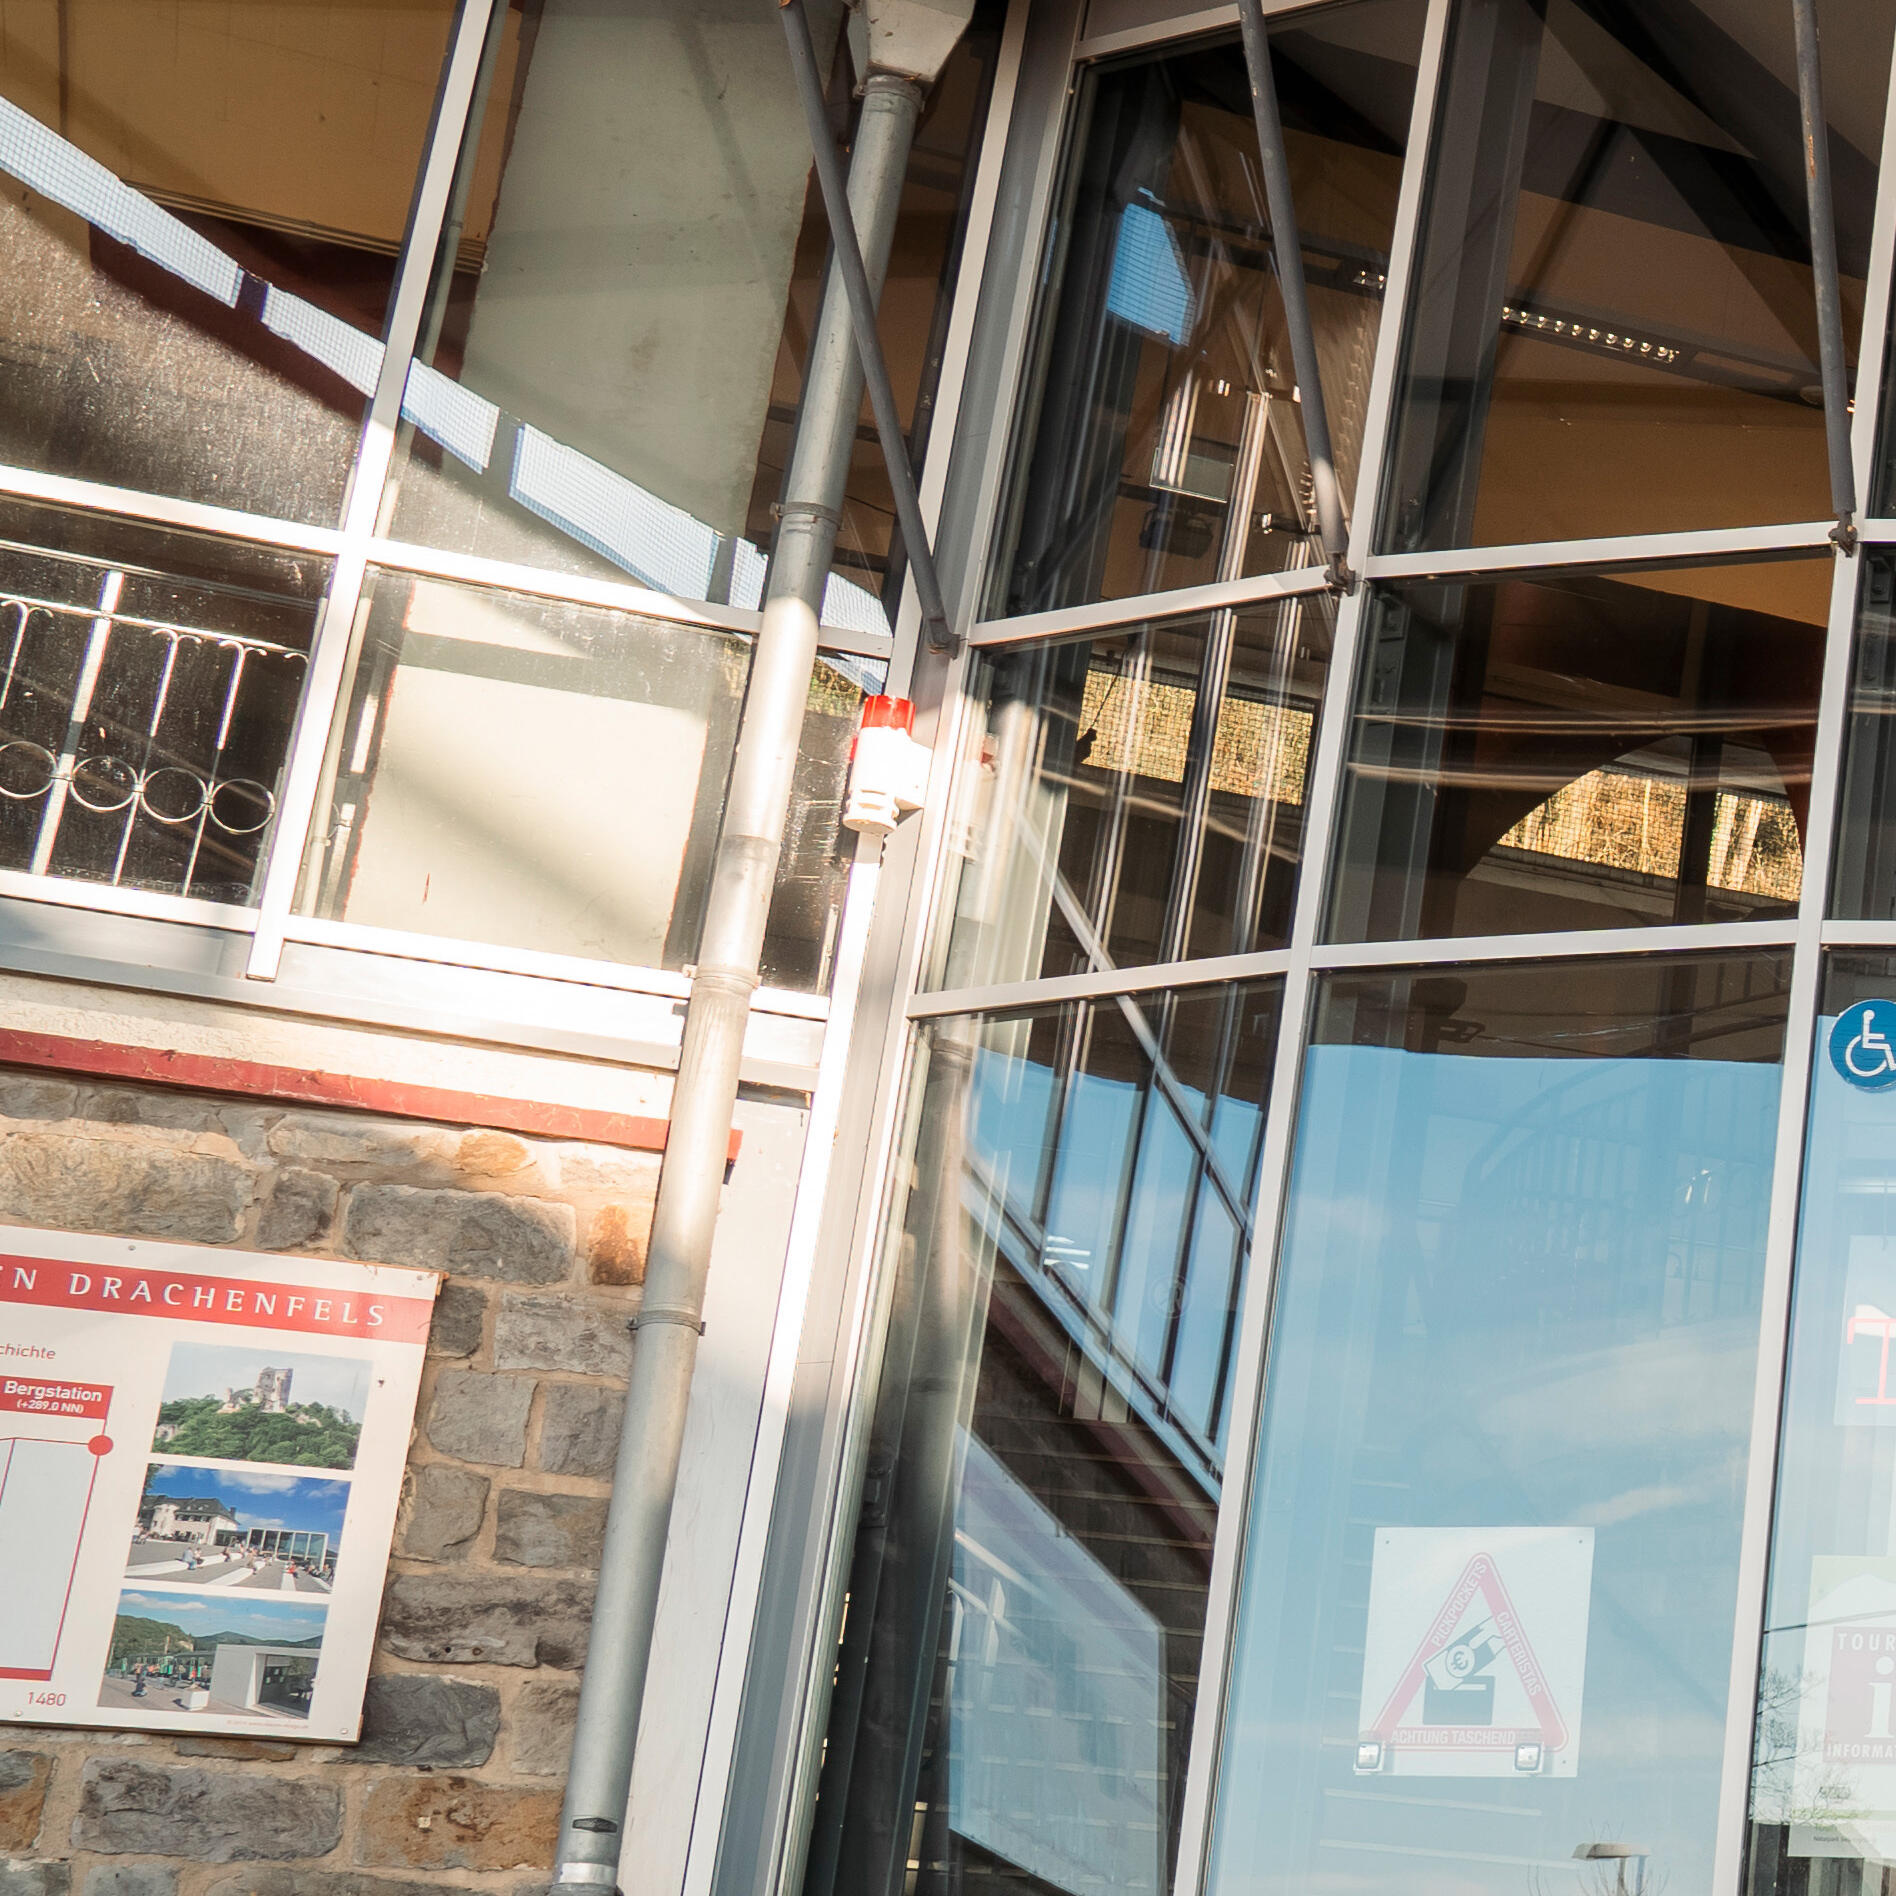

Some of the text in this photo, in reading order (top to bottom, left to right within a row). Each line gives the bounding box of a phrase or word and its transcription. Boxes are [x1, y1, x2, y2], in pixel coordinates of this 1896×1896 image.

[0, 1265, 385, 1328] N DRACHENFELS
[4, 1380, 103, 1403] Bergstation
[61, 1402, 84, 1415] NN)
[1431, 1560, 1488, 1649] PICKPOCKETS
[1496, 1610, 1544, 1697] CARTERISTAS
[27, 1689, 67, 1707] 1480
[1391, 1729, 1541, 1745] ACHTUNG TASCHEND
